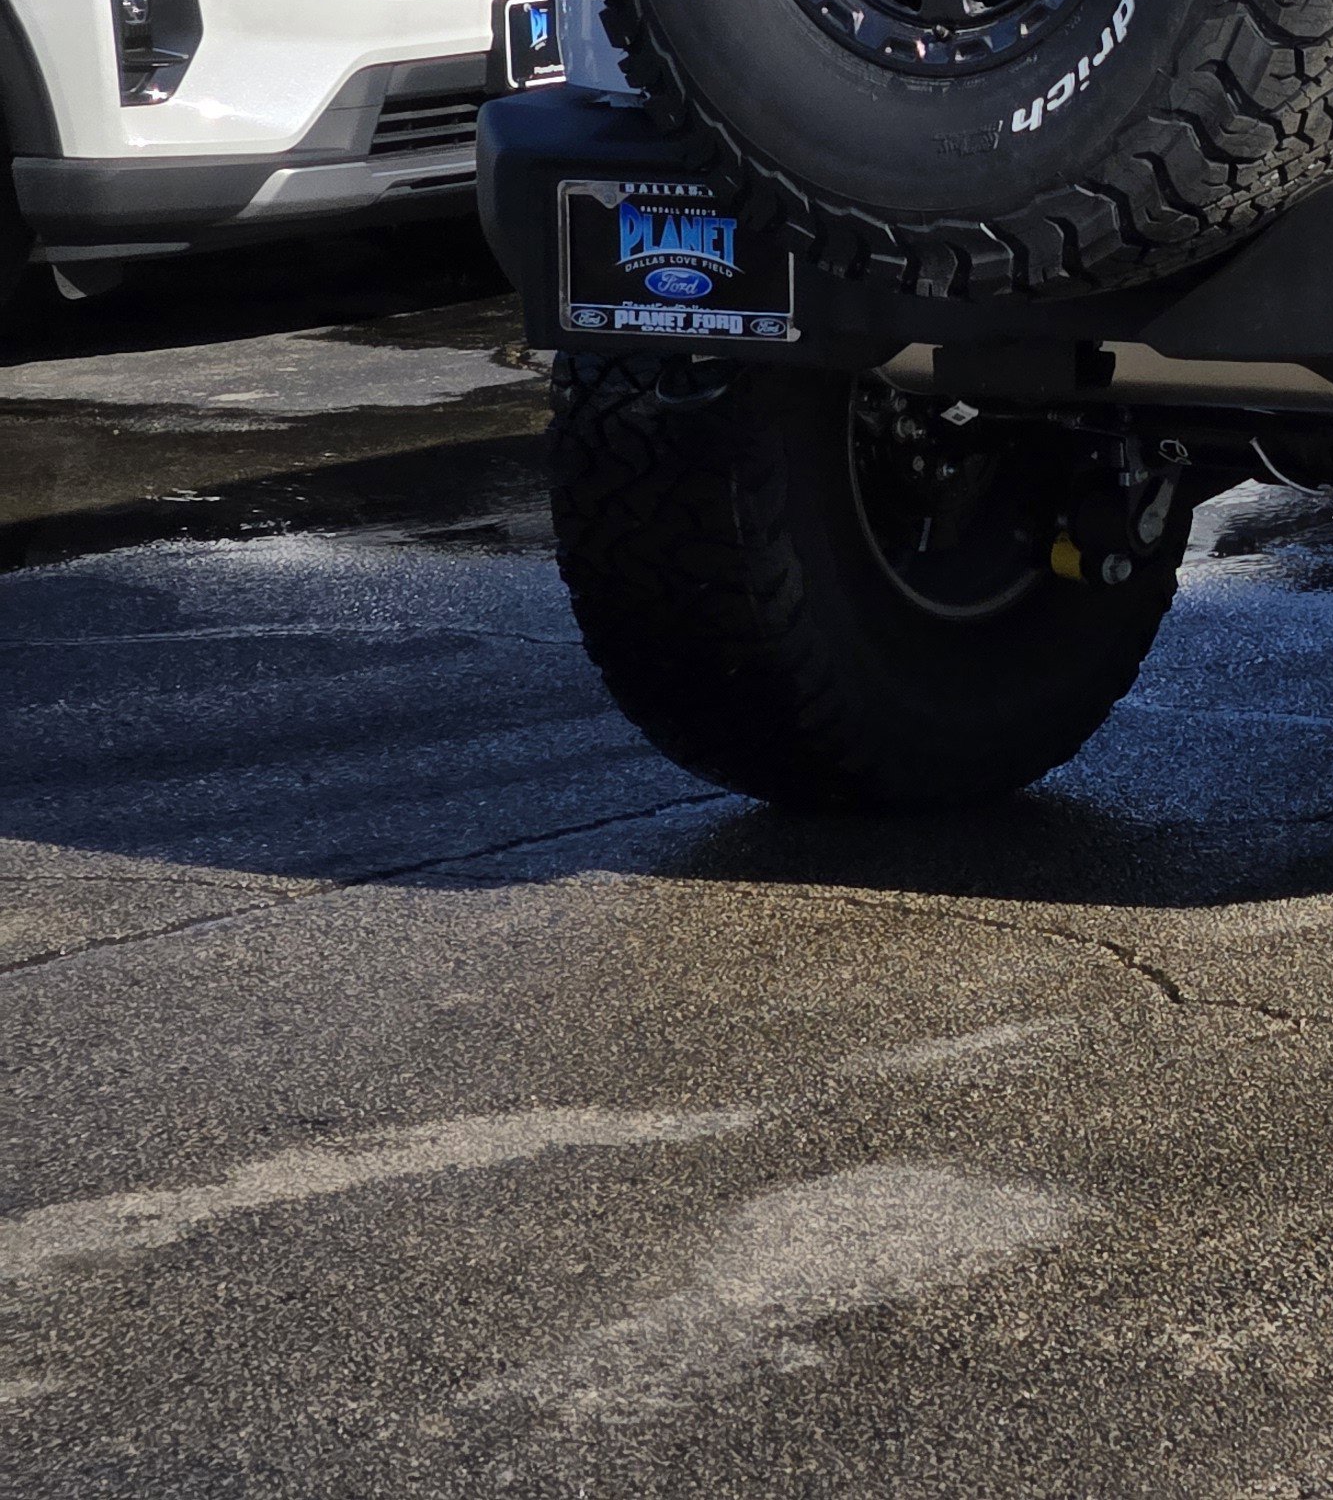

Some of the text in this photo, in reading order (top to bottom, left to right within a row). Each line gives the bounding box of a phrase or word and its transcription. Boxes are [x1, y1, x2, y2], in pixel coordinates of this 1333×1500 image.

[618, 202, 738, 266] PLANET
[625, 255, 733, 278] DALLAS LOVE FIELD
[657, 271, 700, 295] Ford
[614, 310, 743, 335] PLANET FORD
[641, 325, 709, 335] DALLAS
